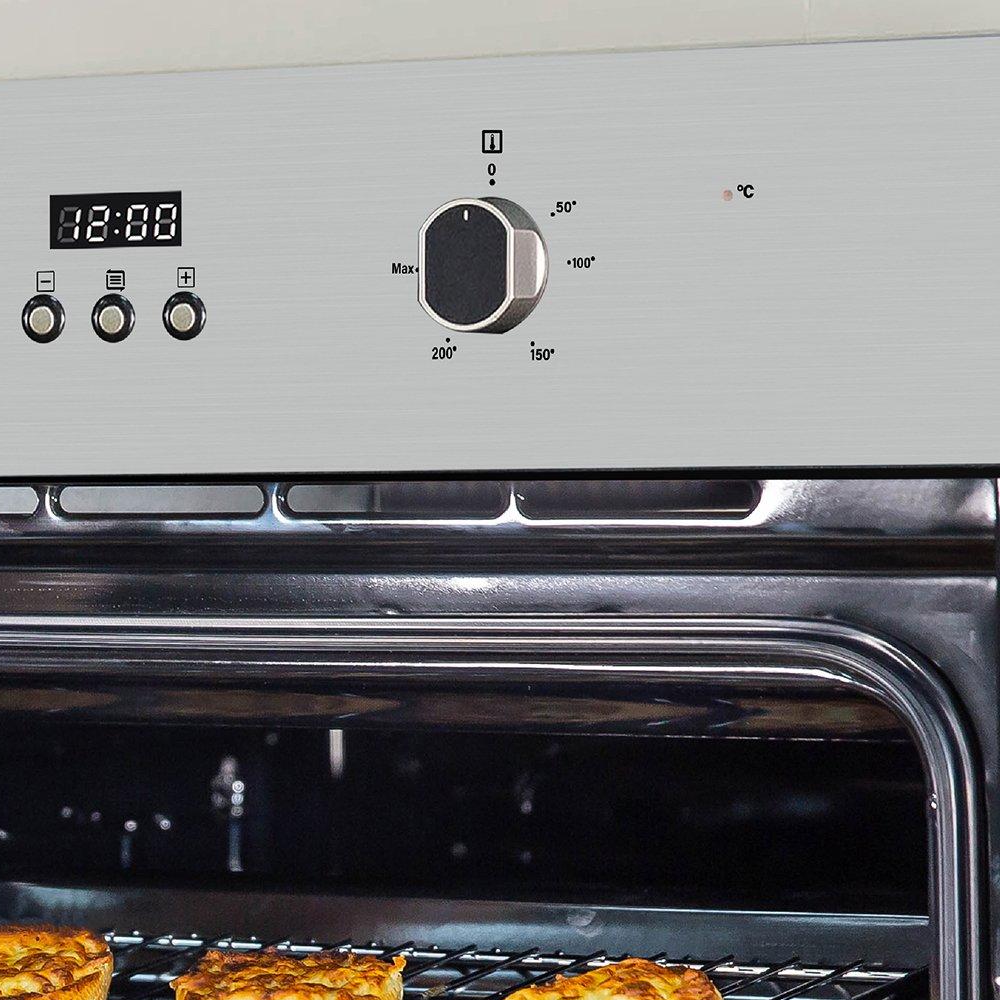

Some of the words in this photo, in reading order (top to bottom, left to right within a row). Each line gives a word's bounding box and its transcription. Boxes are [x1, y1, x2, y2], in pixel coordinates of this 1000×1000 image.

[488, 164, 496, 176] 0
[72, 203, 177, 242] 12:00
[391, 262, 414, 274] Max
